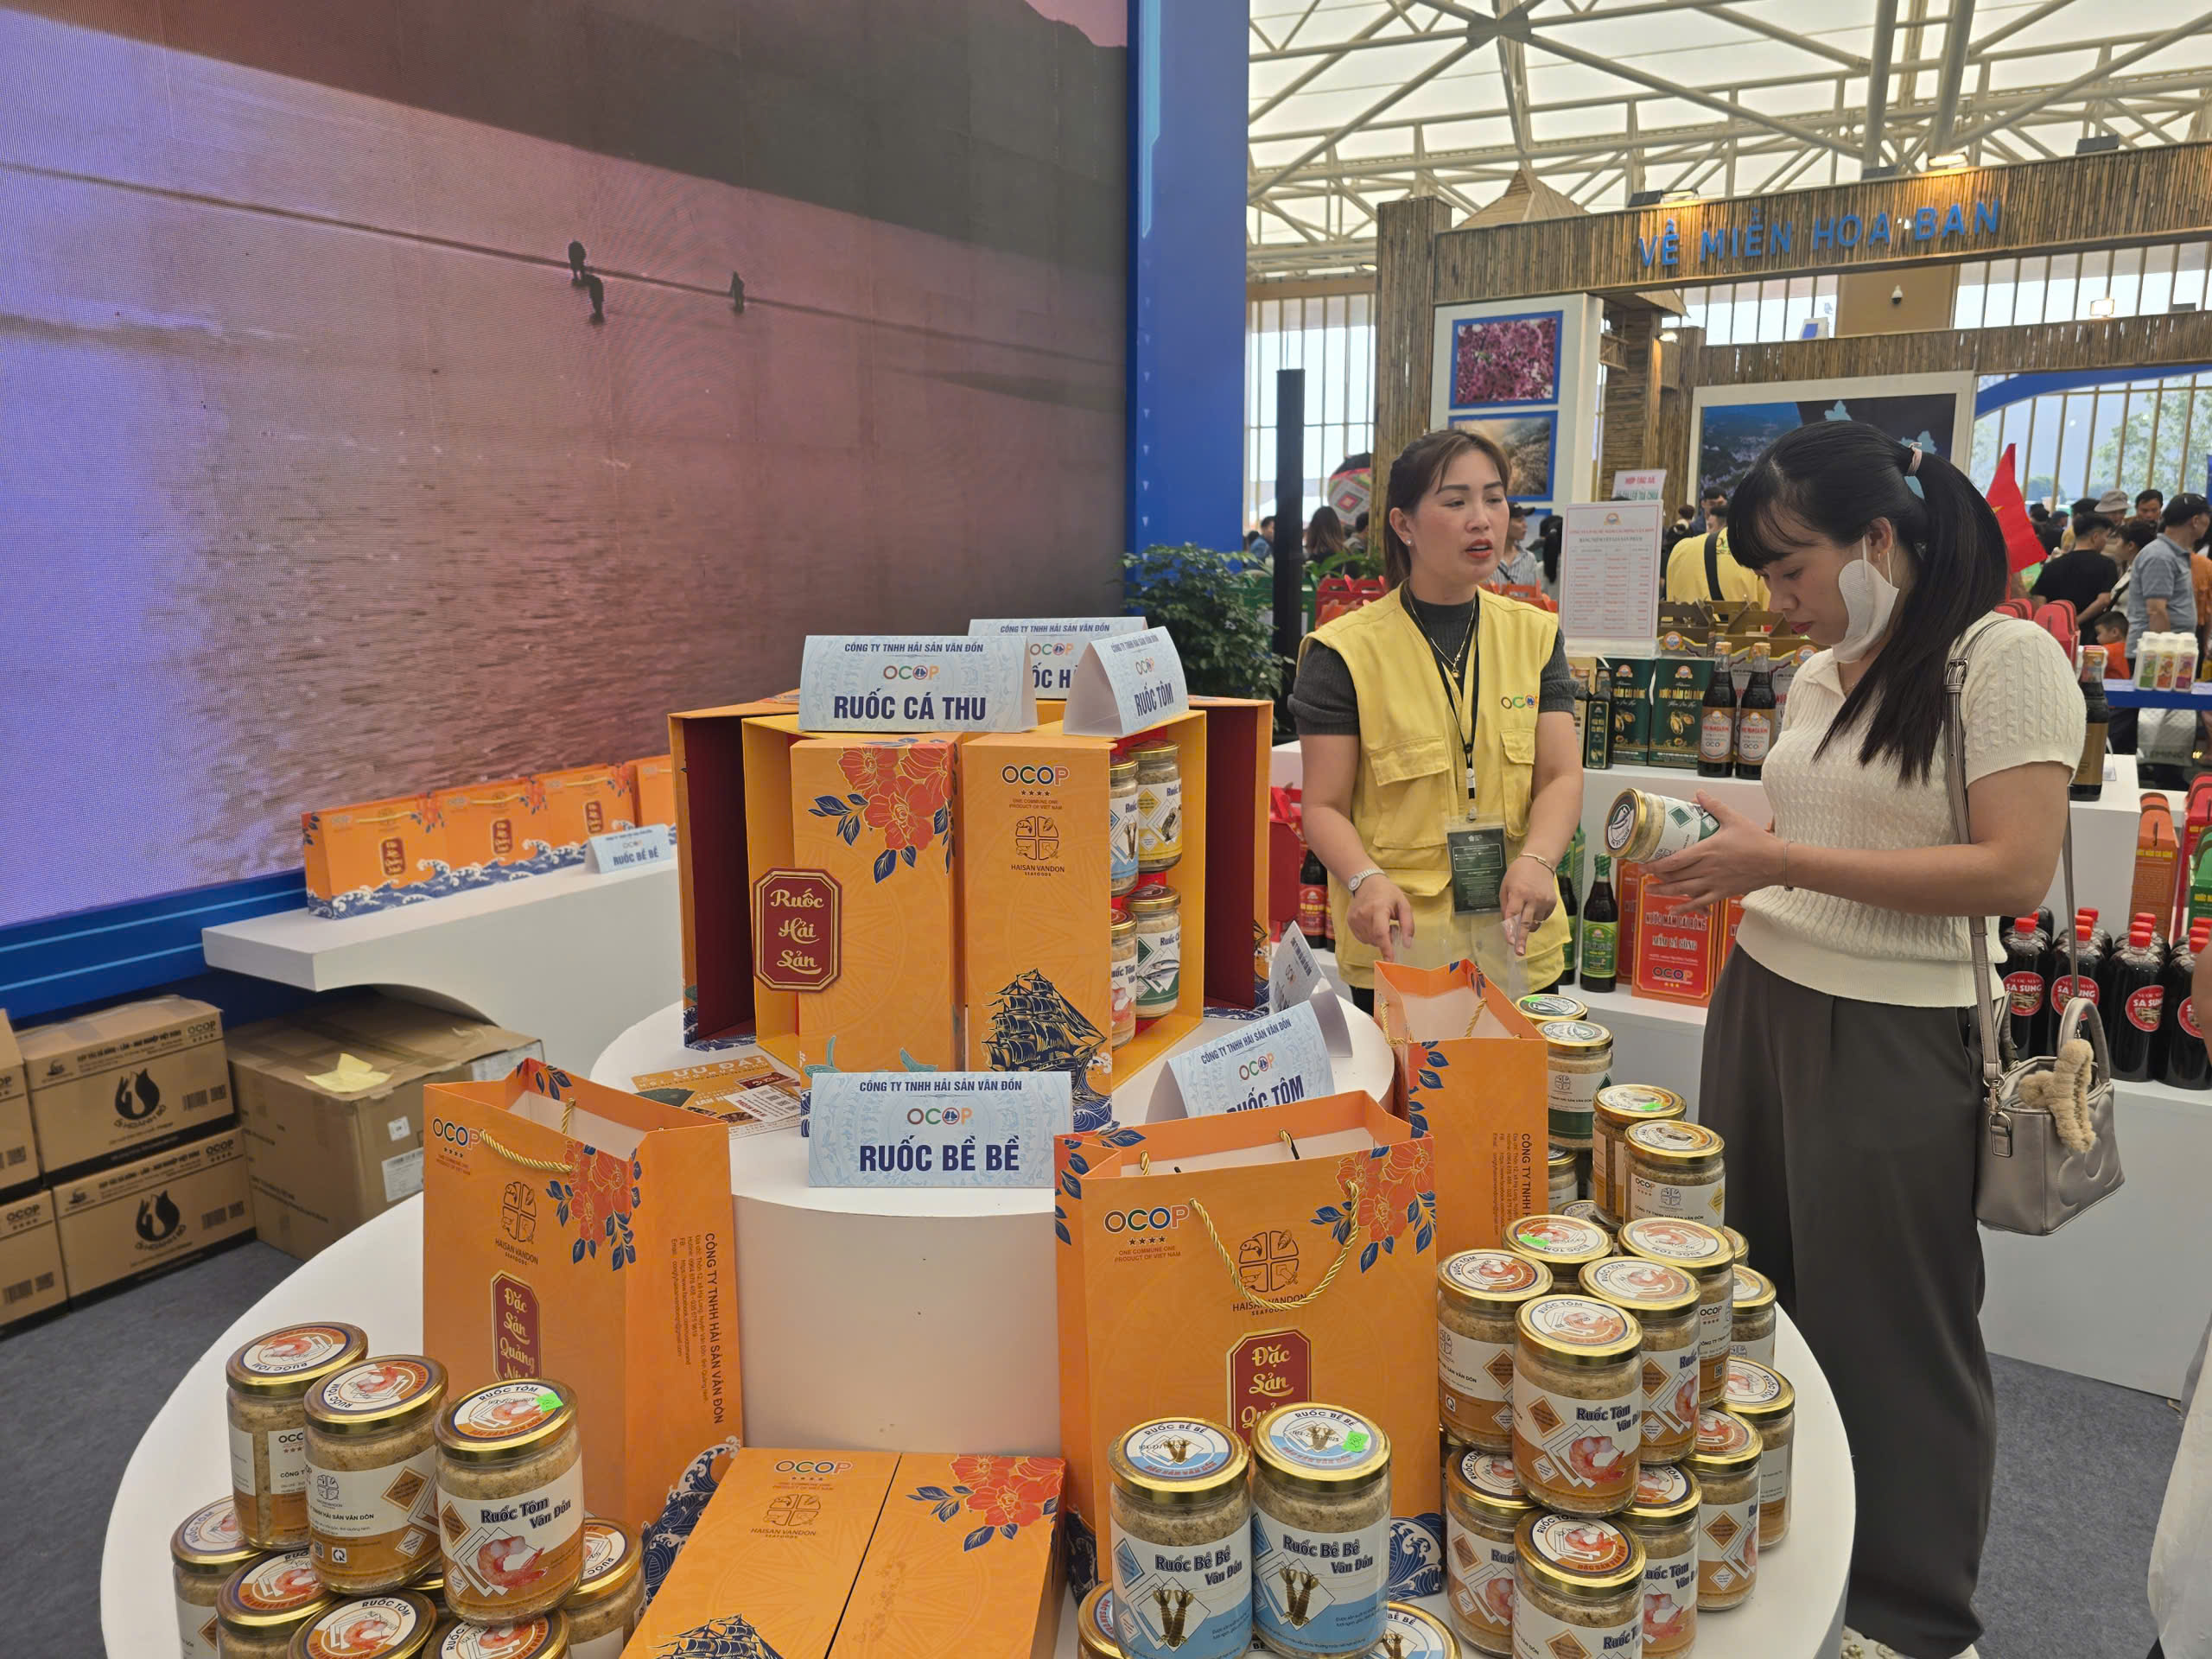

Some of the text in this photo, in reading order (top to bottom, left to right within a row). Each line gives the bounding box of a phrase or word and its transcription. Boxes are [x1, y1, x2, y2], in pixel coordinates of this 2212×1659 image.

[1639, 200, 1999, 267] VỀ MIỀN HOA BAN
[845, 641, 868, 652] CÔNG
[870, 644, 880, 652] TY
[882, 644, 905, 652] TNHH
[907, 641, 923, 652] HẢI
[925, 641, 943, 652] SẢN
[945, 642, 963, 652] VÂN
[1030, 643, 1074, 656] OCOP
[884, 665, 939, 680] OCOP
[1032, 663, 1052, 689] ỐC
[834, 685, 986, 721] RUỐC CÁ THU
[1134, 680, 1174, 716] RUỐC TÔM
[1501, 695, 1538, 709] OCO
[1001, 764, 1070, 786] OCOP
[770, 888, 824, 909] Ruốc
[779, 918, 819, 944] Hải
[777, 949, 822, 975] Sản
[1653, 967, 1693, 982] OCOP
[2148, 998, 2164, 1007] SUN
[188, 1020, 216, 1035] OCOP
[1201, 1050, 1219, 1065] CÔNG
[1217, 1046, 1227, 1058] TY
[1227, 1040, 1243, 1054] TNHH
[1239, 1052, 1275, 1081] OCOP
[860, 1078, 1022, 1091] CÔNG TY TNHH HẢI SẢN VÂN ĐỒN
[1271, 1075, 1305, 1107] TÔM
[907, 1107, 973, 1125] OCOP
[433, 1117, 481, 1150] OCOP
[206, 1139, 234, 1156] OCOP
[860, 1135, 1019, 1172] RUỐC BỀ BỀ
[1522, 1133, 1533, 1210] CÔNG TY TNHH
[1636, 1177, 1656, 1190] OCOP
[1103, 1205, 1190, 1234] OCOP
[495, 1238, 538, 1265] HAISAN VANDON
[705, 1232, 718, 1268] CÔNG
[1115, 1255, 1143, 1263] PRODUCT
[707, 1269, 718, 1285] TY
[504, 1287, 527, 1314] Đặc
[708, 1287, 719, 1320] TNHH
[1232, 1300, 1264, 1312] HAISA
[1538, 1301, 1559, 1314] RUỐC
[1700, 1306, 1722, 1316] OCOP
[503, 1316, 531, 1345] Sản
[499, 1338, 536, 1372] Quảng
[1252, 1344, 1291, 1368] Đặc
[479, 1384, 539, 1402] RUỐC TÔM
[1249, 1371, 1294, 1396] Sản
[329, 1397, 352, 1409] RUỐC
[1576, 1404, 1630, 1421] Ruốc Tôm
[1295, 1409, 1326, 1418] RUỐC
[1144, 1424, 1175, 1435] RUỐC
[1616, 1418, 1631, 1433] Vân
[775, 1460, 853, 1474] OCOP
[1462, 1463, 1478, 1480] RUỐC
[480, 1497, 550, 1524] Ruốc Tôm
[529, 1498, 571, 1529] Vân Đồn
[1536, 1517, 1556, 1535] RUỐC
[1282, 1534, 1360, 1558] Ruốc Bề Bề
[1155, 1545, 1231, 1572] Ruốc Bề Bề
[1331, 1555, 1373, 1574] Vân Đồn
[1205, 1560, 1243, 1586] Vân Đồn
[1669, 1561, 1689, 1578] Tôm
[362, 1599, 411, 1618] RUỐC TÔM
[446, 1628, 466, 1650] RUỐC
[1603, 1631, 1630, 1650] Ruốc
